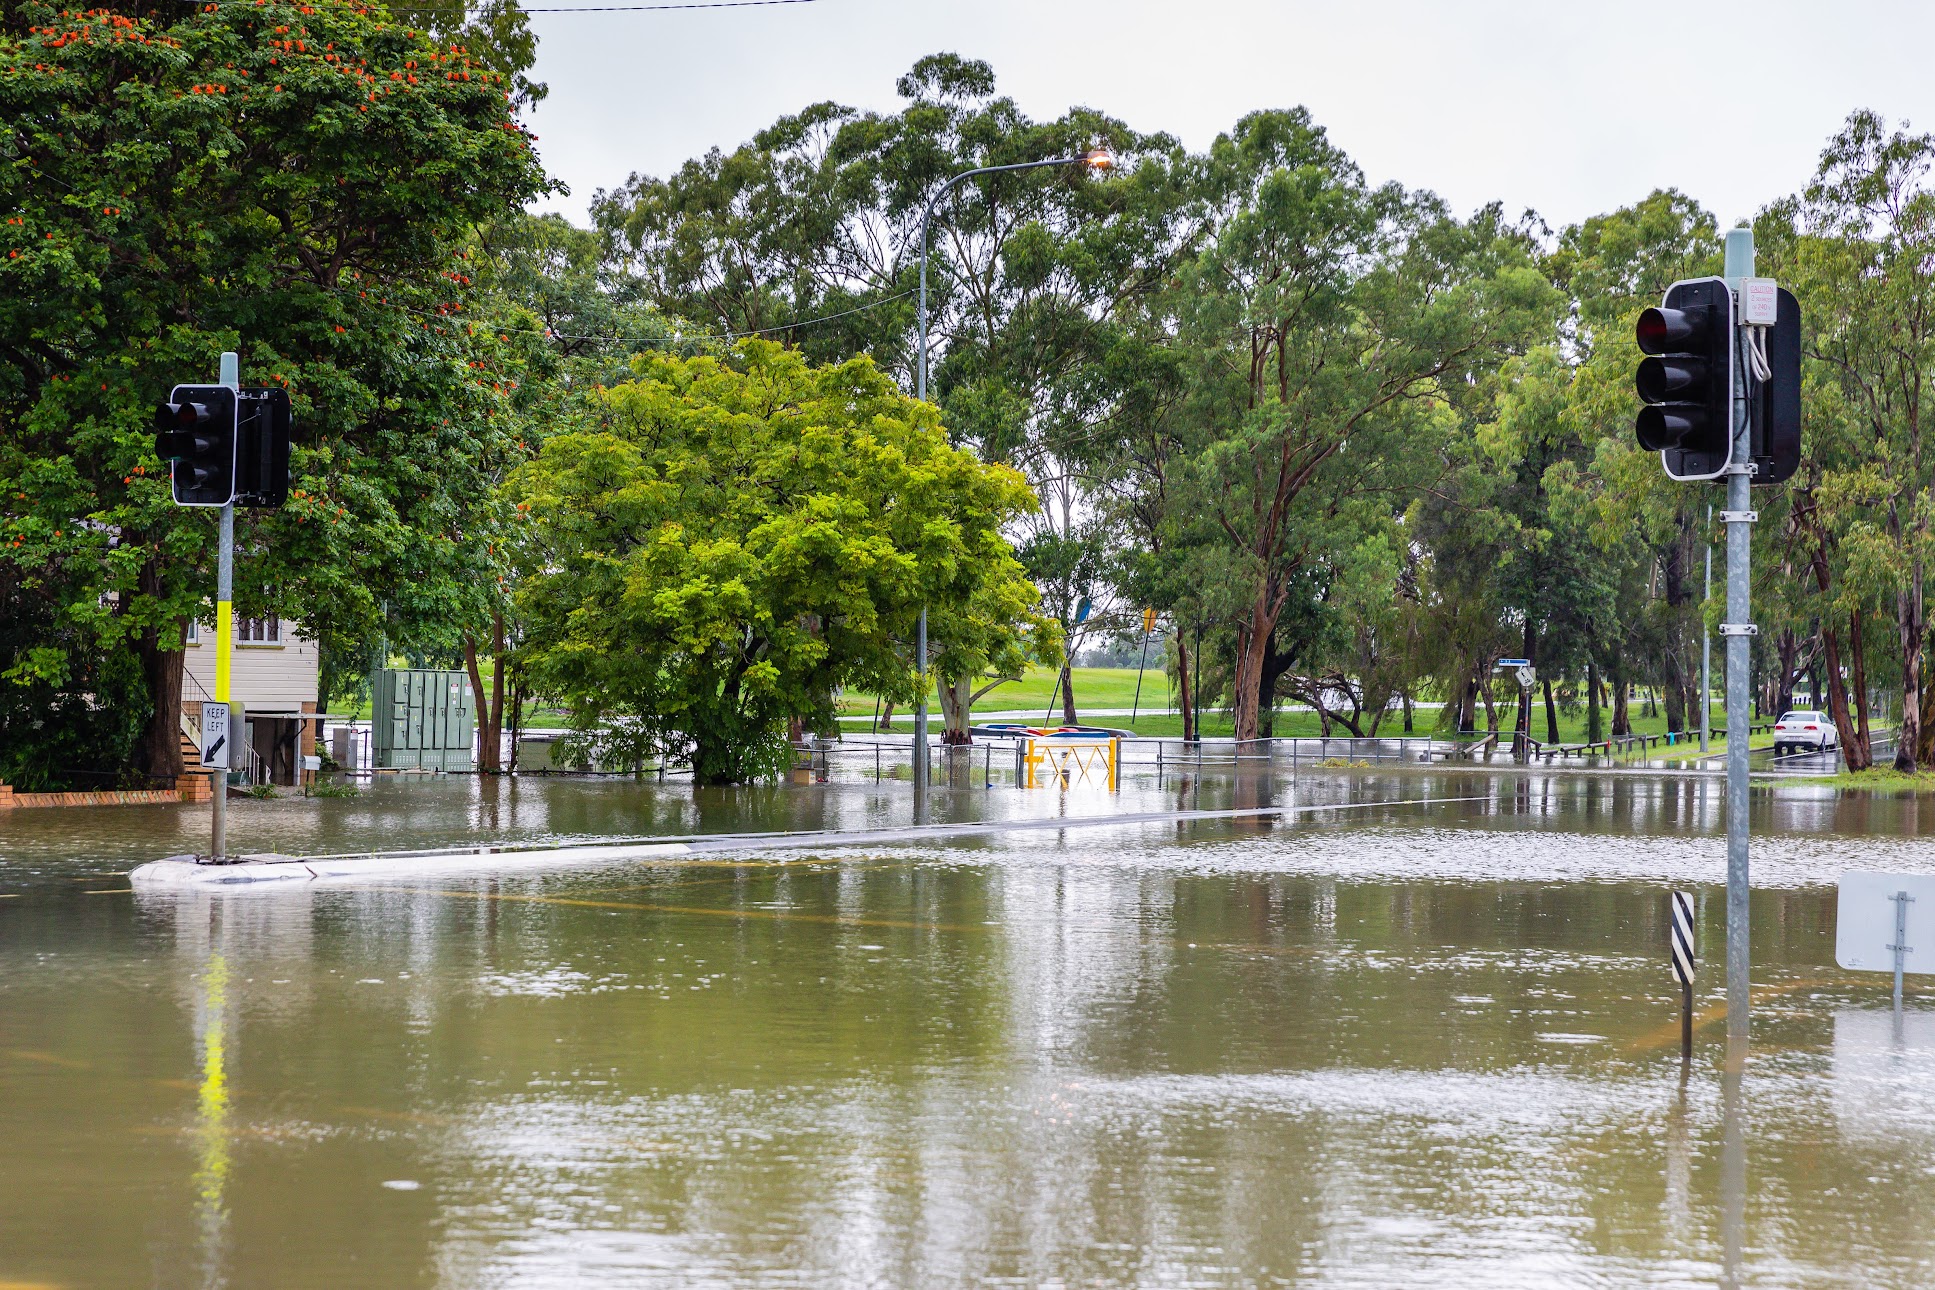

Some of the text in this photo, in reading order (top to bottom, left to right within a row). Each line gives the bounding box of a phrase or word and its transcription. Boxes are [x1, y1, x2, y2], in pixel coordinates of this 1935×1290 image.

[1750, 285, 1774, 293] CAUTION
[206, 708, 225, 718] KEEP
[207, 721, 224, 732] LEFT
